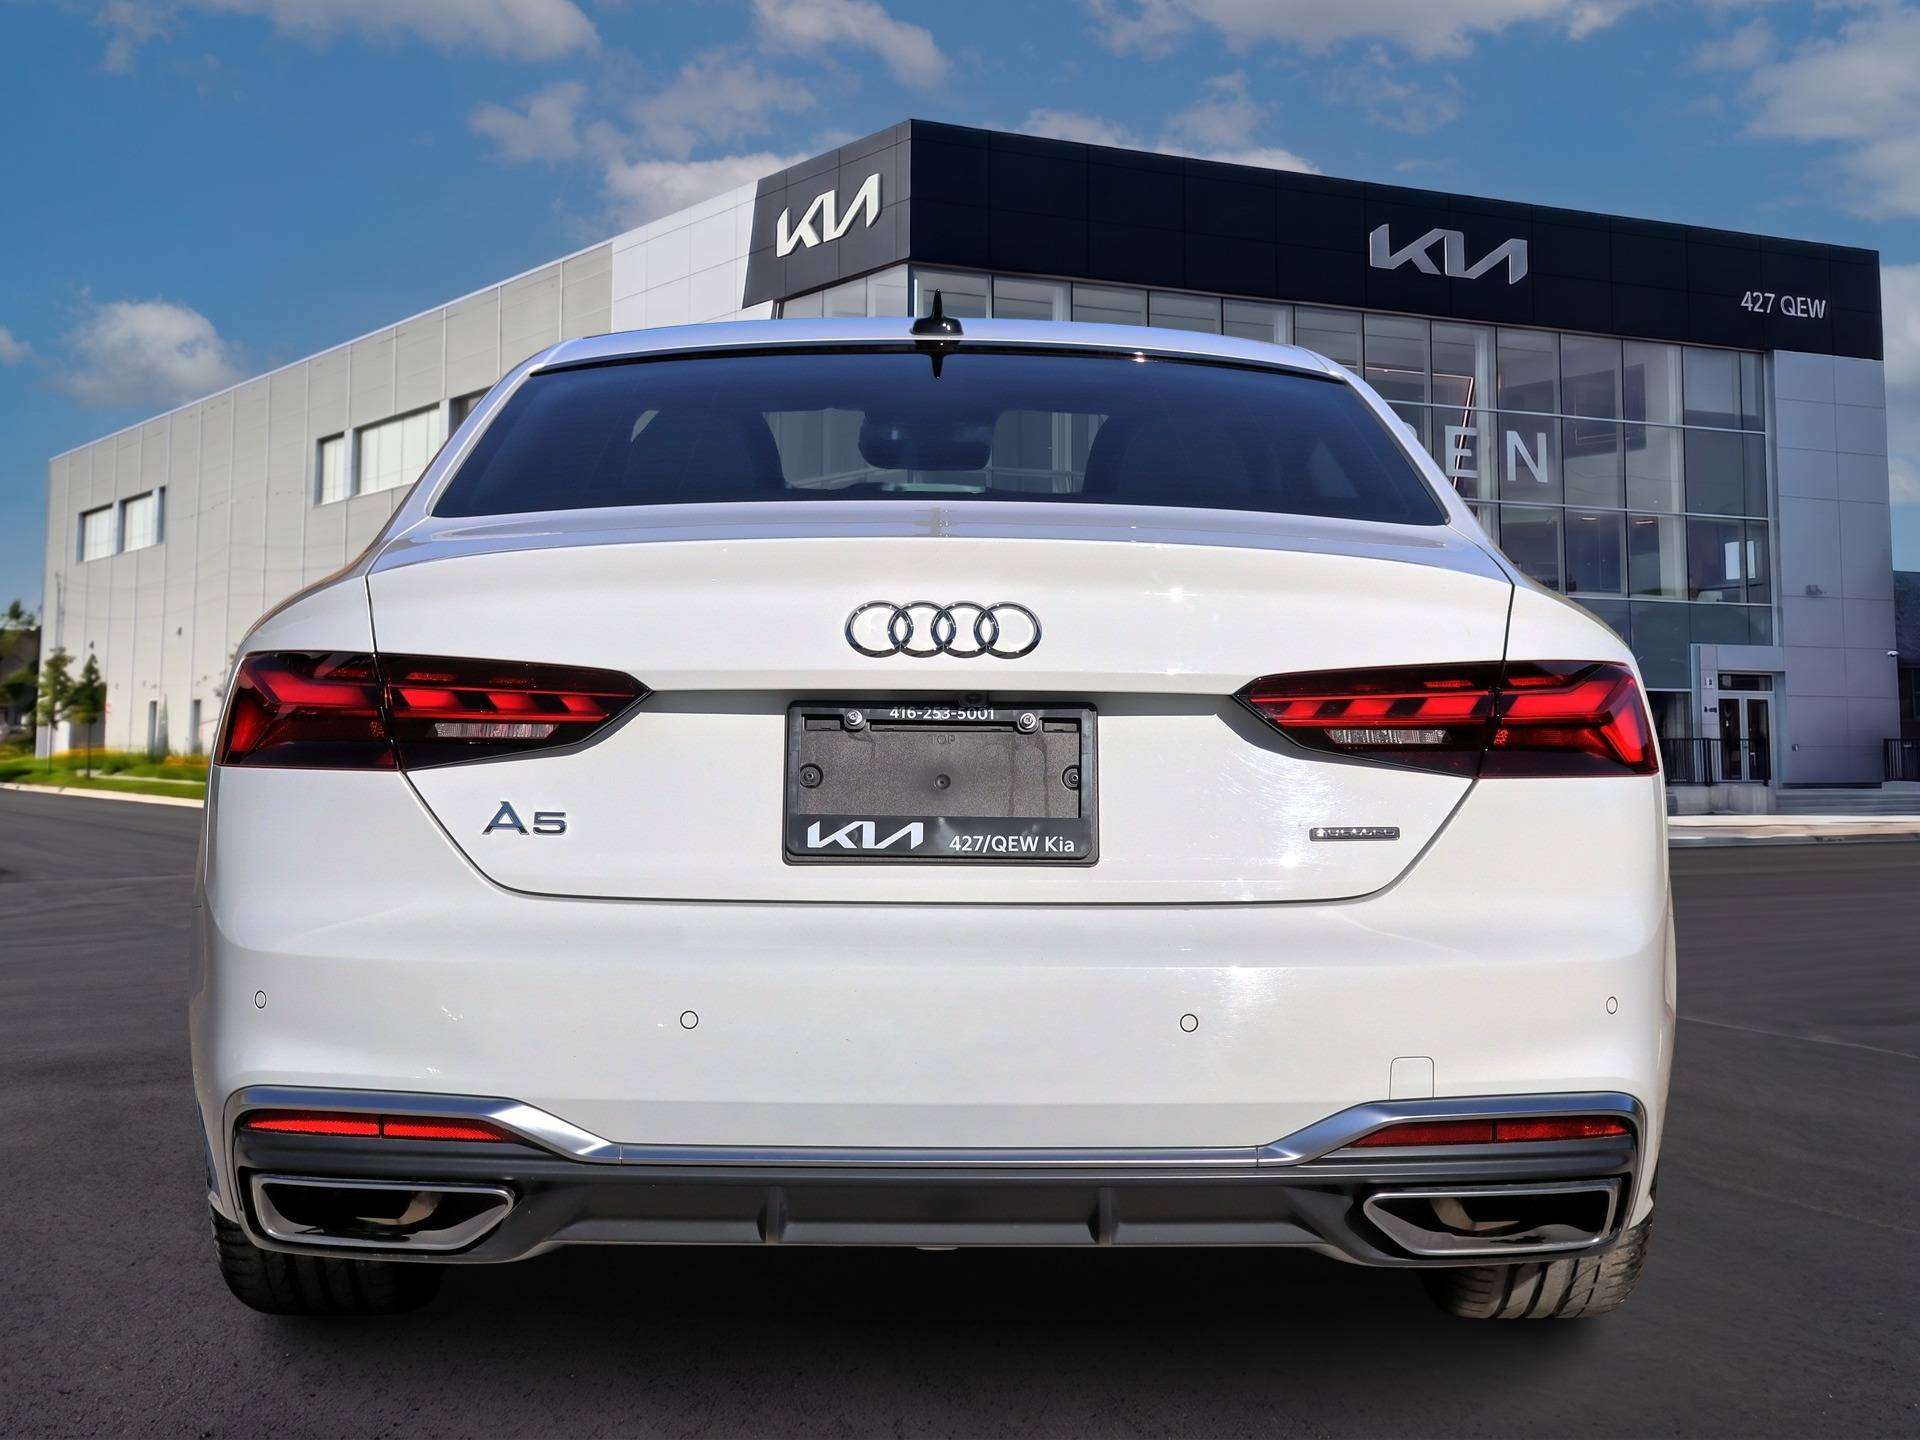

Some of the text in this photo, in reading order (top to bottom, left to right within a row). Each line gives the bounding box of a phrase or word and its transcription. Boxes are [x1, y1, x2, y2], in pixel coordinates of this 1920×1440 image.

[777, 173, 880, 257] KIA
[1370, 224, 1527, 285] KIA
[1740, 291, 1826, 318] 427 QEW
[889, 705, 995, 720] 416-253-5001
[482, 800, 567, 835] A5
[807, 820, 924, 849] KIA
[949, 834, 1075, 853] 427/QEW Kia
